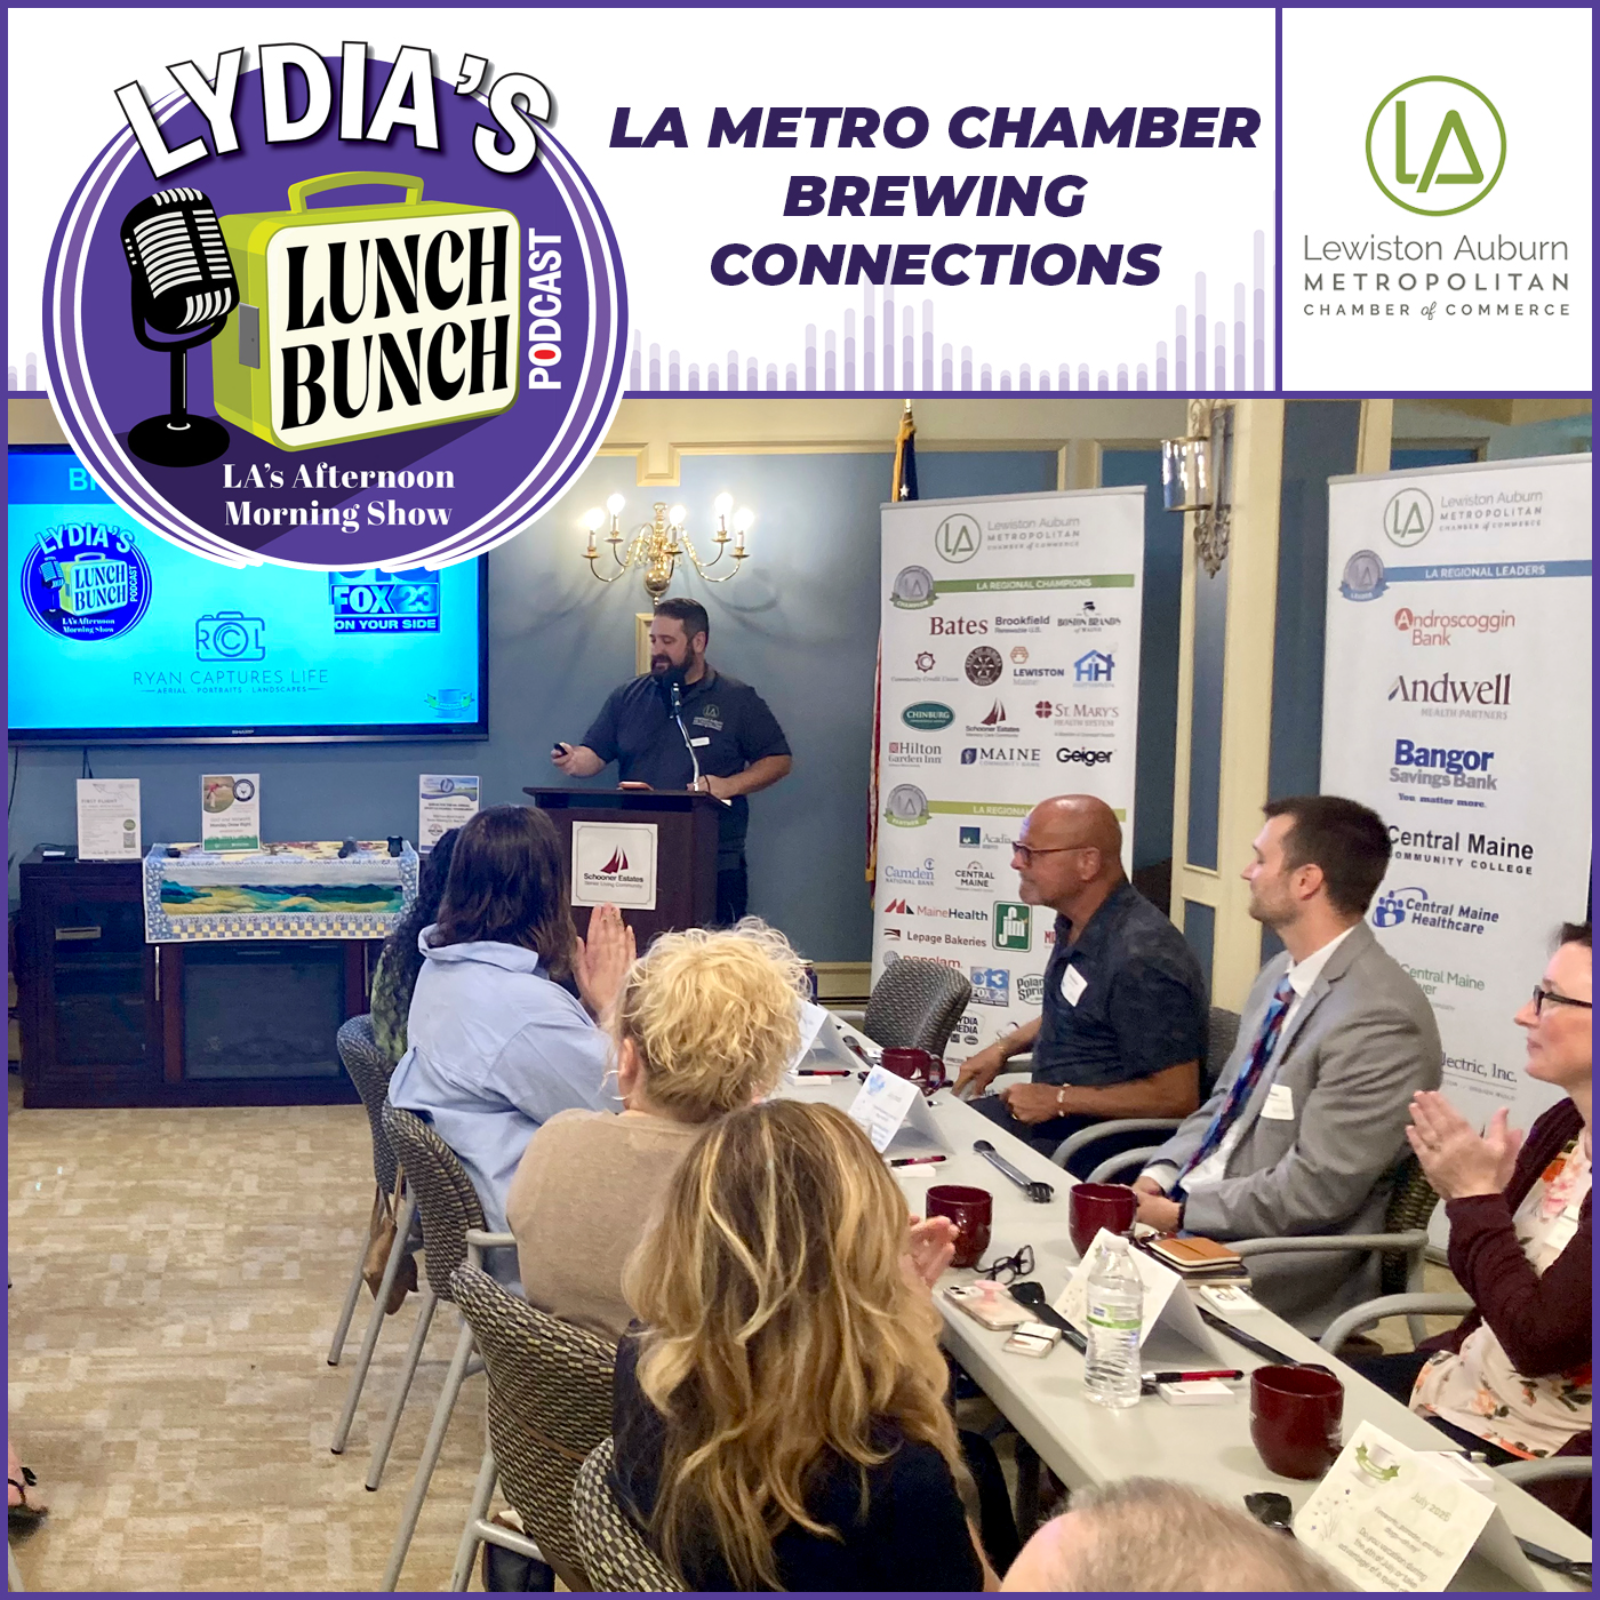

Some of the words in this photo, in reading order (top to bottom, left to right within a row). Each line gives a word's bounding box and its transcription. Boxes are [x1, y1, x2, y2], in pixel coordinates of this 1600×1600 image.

[1441, 494, 1494, 508] Lewiston
[1497, 491, 1543, 505] Auburn
[1394, 499, 1425, 538] LA
[1440, 507, 1542, 520] METROPOLITAN
[988, 520, 1036, 531] Lewiston
[1039, 517, 1080, 528] Auburn
[1439, 523, 1479, 532] CHAMBER
[1492, 520, 1541, 529] COMMERCE
[34, 522, 135, 554] LYDIA'S
[945, 522, 974, 556] LA
[987, 530, 1080, 541] METROPOLITAN
[75, 564, 125, 589] LUNCH
[1425, 569, 1439, 579] LA
[1440, 567, 1494, 578] REGIONAL
[1496, 565, 1546, 576] LEADERS
[128, 565, 138, 602] PODCAST
[976, 582, 988, 591] LA
[989, 580, 1034, 590] REGIONAL
[1036, 578, 1092, 589] CHAMPIONS
[75, 585, 126, 611] BUNCH
[333, 585, 392, 614] FOX
[398, 585, 435, 612] 23
[335, 620, 355, 630] ON
[359, 619, 398, 629] YOUR
[402, 619, 436, 629] SIDE
[929, 617, 988, 636] Bates
[995, 616, 1050, 626] Brookfield
[1394, 608, 1515, 633] Androscoggin
[1412, 629, 1451, 646] Bank
[134, 671, 182, 685] RYAN
[190, 670, 283, 685] CAPTURES
[291, 669, 329, 684] LIFE
[1013, 668, 1064, 677] LEWISTON
[1388, 672, 1511, 705] Andwell
[906, 711, 950, 719] CHINBURG
[1421, 708, 1457, 718] HEALTH
[1459, 709, 1508, 720] PARTNERS
[900, 742, 941, 755] Hilton
[980, 748, 1041, 760] MAINE
[888, 755, 922, 763] Garden
[924, 756, 941, 764] Inn
[1056, 747, 1113, 767] Geiger
[1395, 739, 1495, 775] Bangor
[1390, 767, 1451, 789] Savings
[1453, 771, 1498, 790] Bank
[1398, 793, 1416, 802] You
[1420, 796, 1454, 804] matter
[973, 806, 985, 814] LA
[1388, 825, 1460, 851] Central
[1468, 833, 1534, 860] Maine
[885, 866, 934, 880] Camden
[955, 870, 995, 879] CENTRAL
[1471, 861, 1533, 875] COLLEGE
[584, 873, 616, 881] Schooner
[961, 879, 989, 887] MAINE
[917, 906, 988, 921] MaineHealth
[1406, 898, 1454, 916] Central
[1458, 906, 1499, 923] Maine
[1411, 912, 1485, 935] Healthcare
[907, 931, 942, 944] Lepage
[945, 934, 987, 947] Bakeries
[1017, 978, 1044, 990] Polan
[1447, 972, 1485, 991] Maine
[959, 1016, 978, 1026] YDIA
[1492, 1063, 1517, 1082] Inc.
[1411, 1492, 1429, 1510] July
